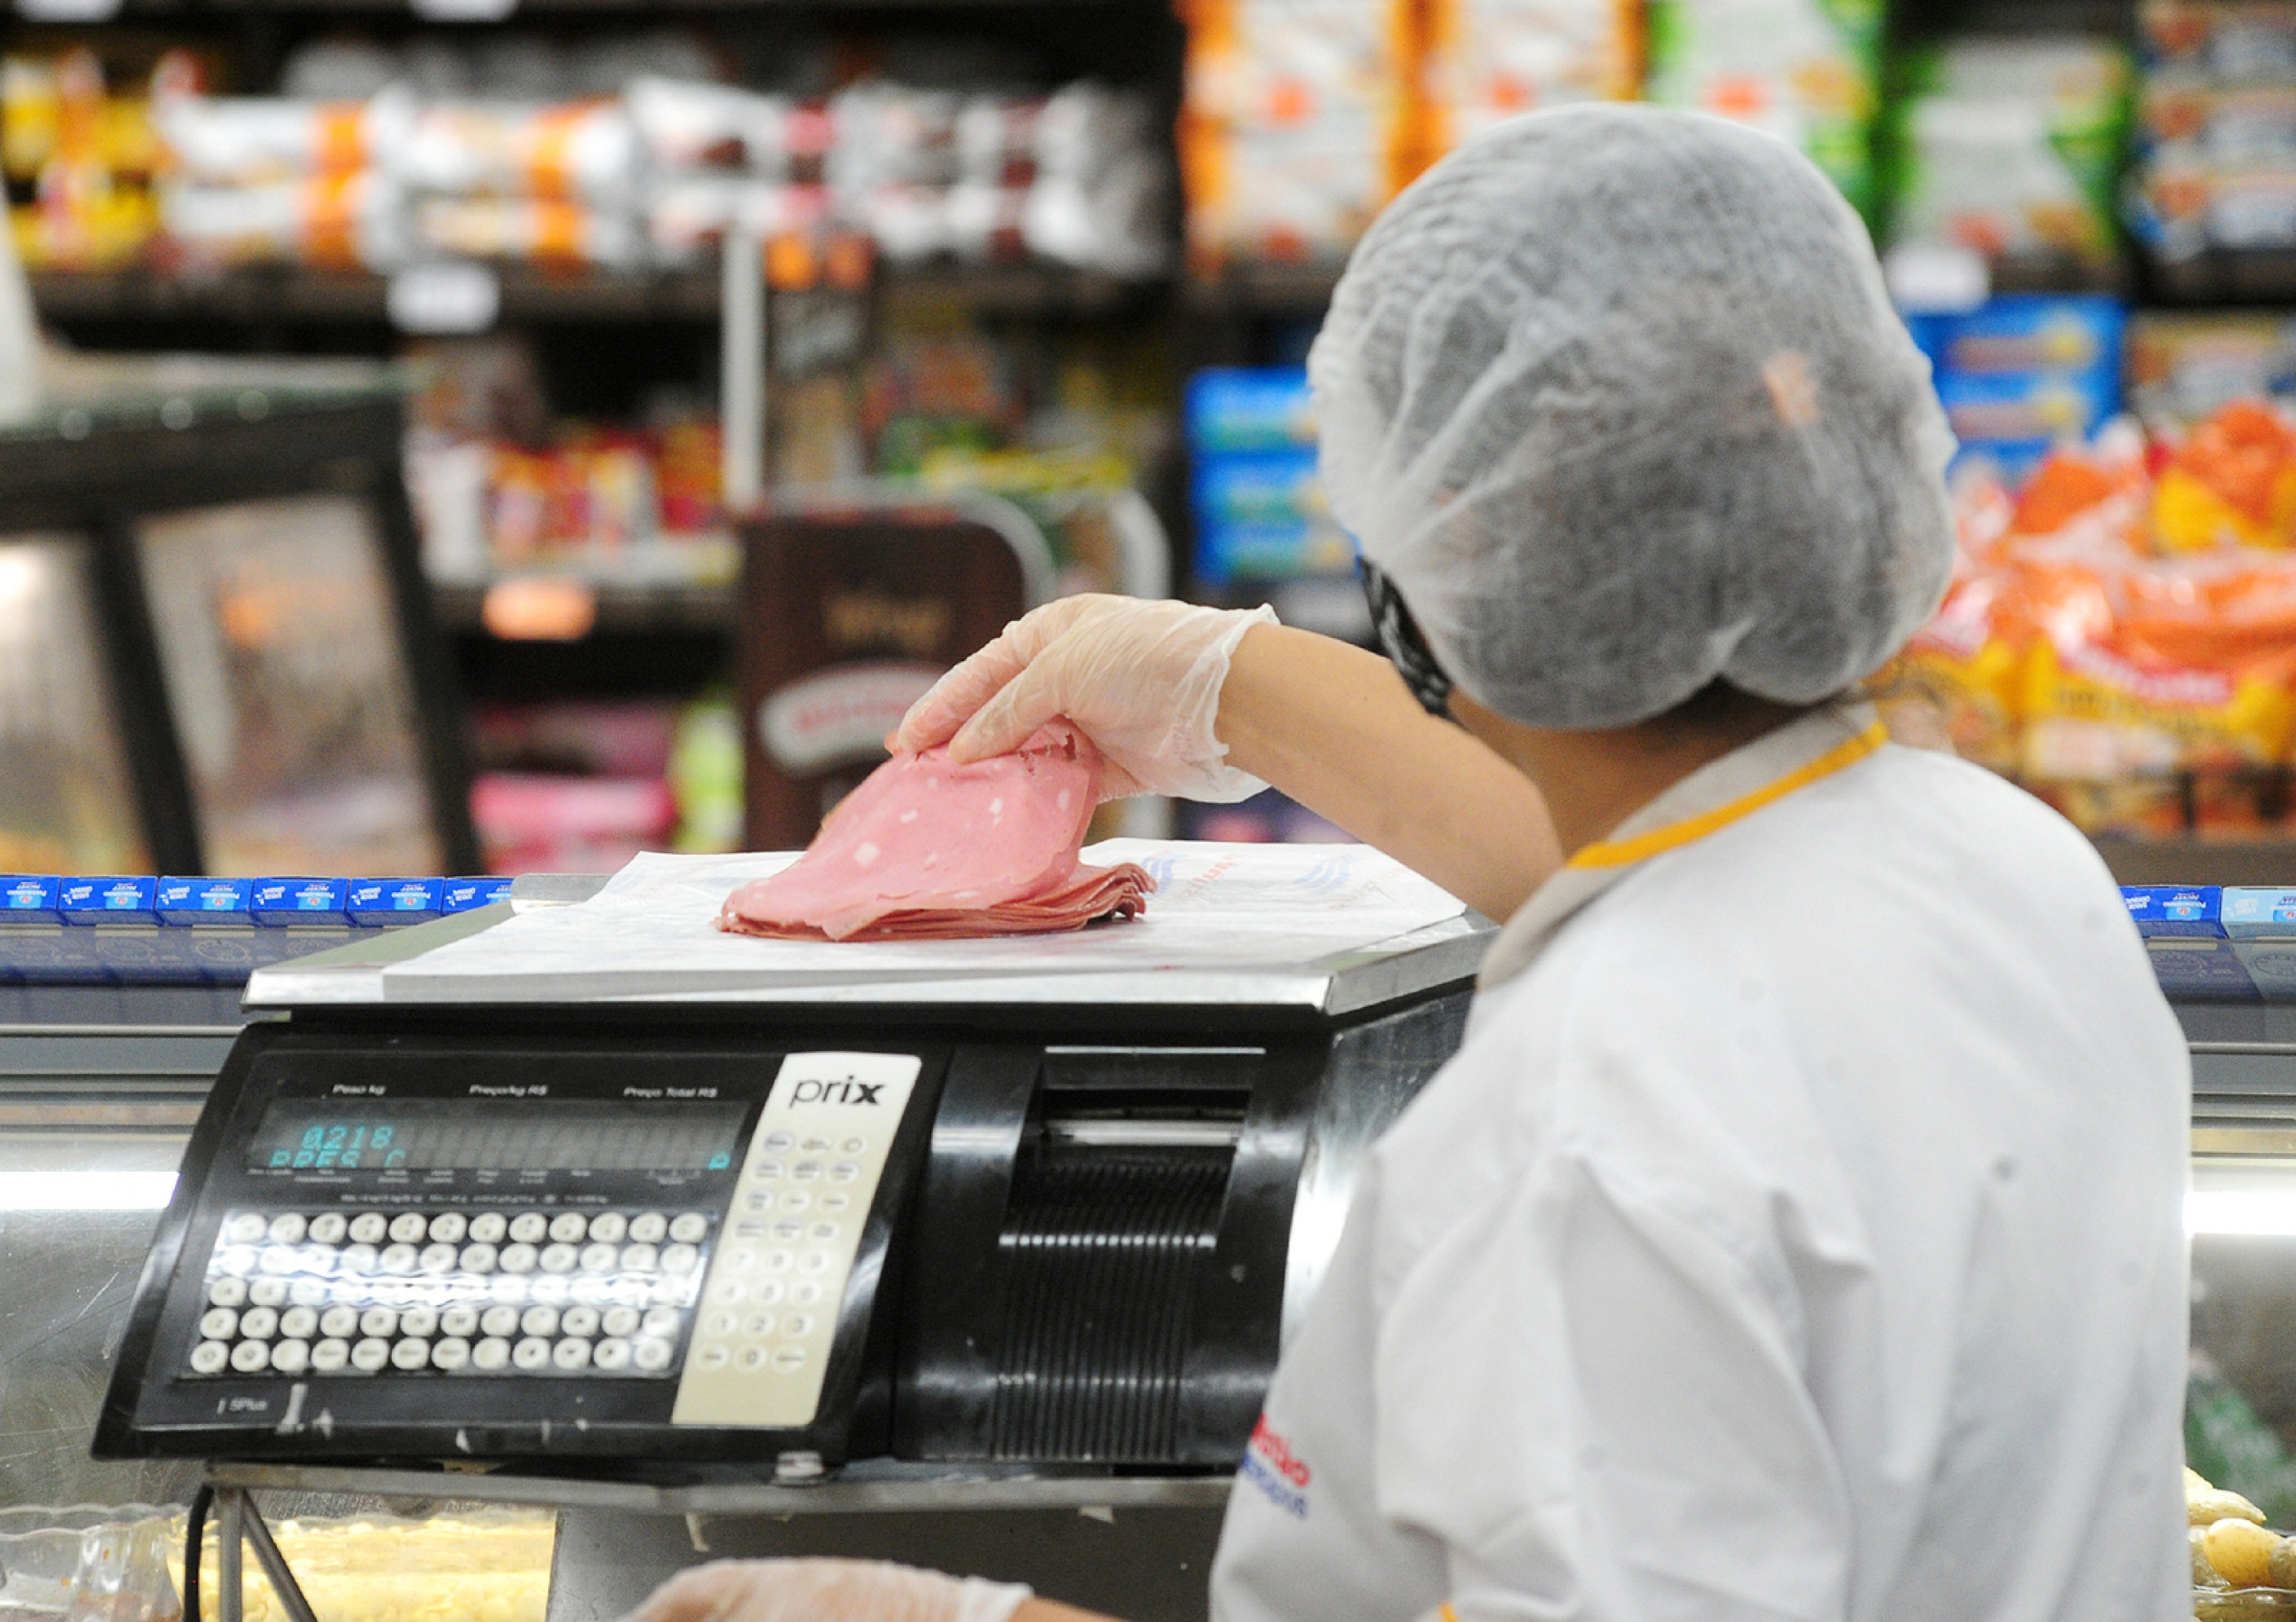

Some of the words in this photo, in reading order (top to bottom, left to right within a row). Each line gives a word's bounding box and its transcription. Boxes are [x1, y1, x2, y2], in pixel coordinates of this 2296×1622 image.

[332, 1084, 366, 1094] Peso
[369, 1084, 387, 1096] kg
[528, 1084, 548, 1096] R$
[624, 1087, 663, 1099] Preço
[666, 1087, 696, 1098] Total
[698, 1087, 718, 1098] R$
[789, 1075, 885, 1109] prix
